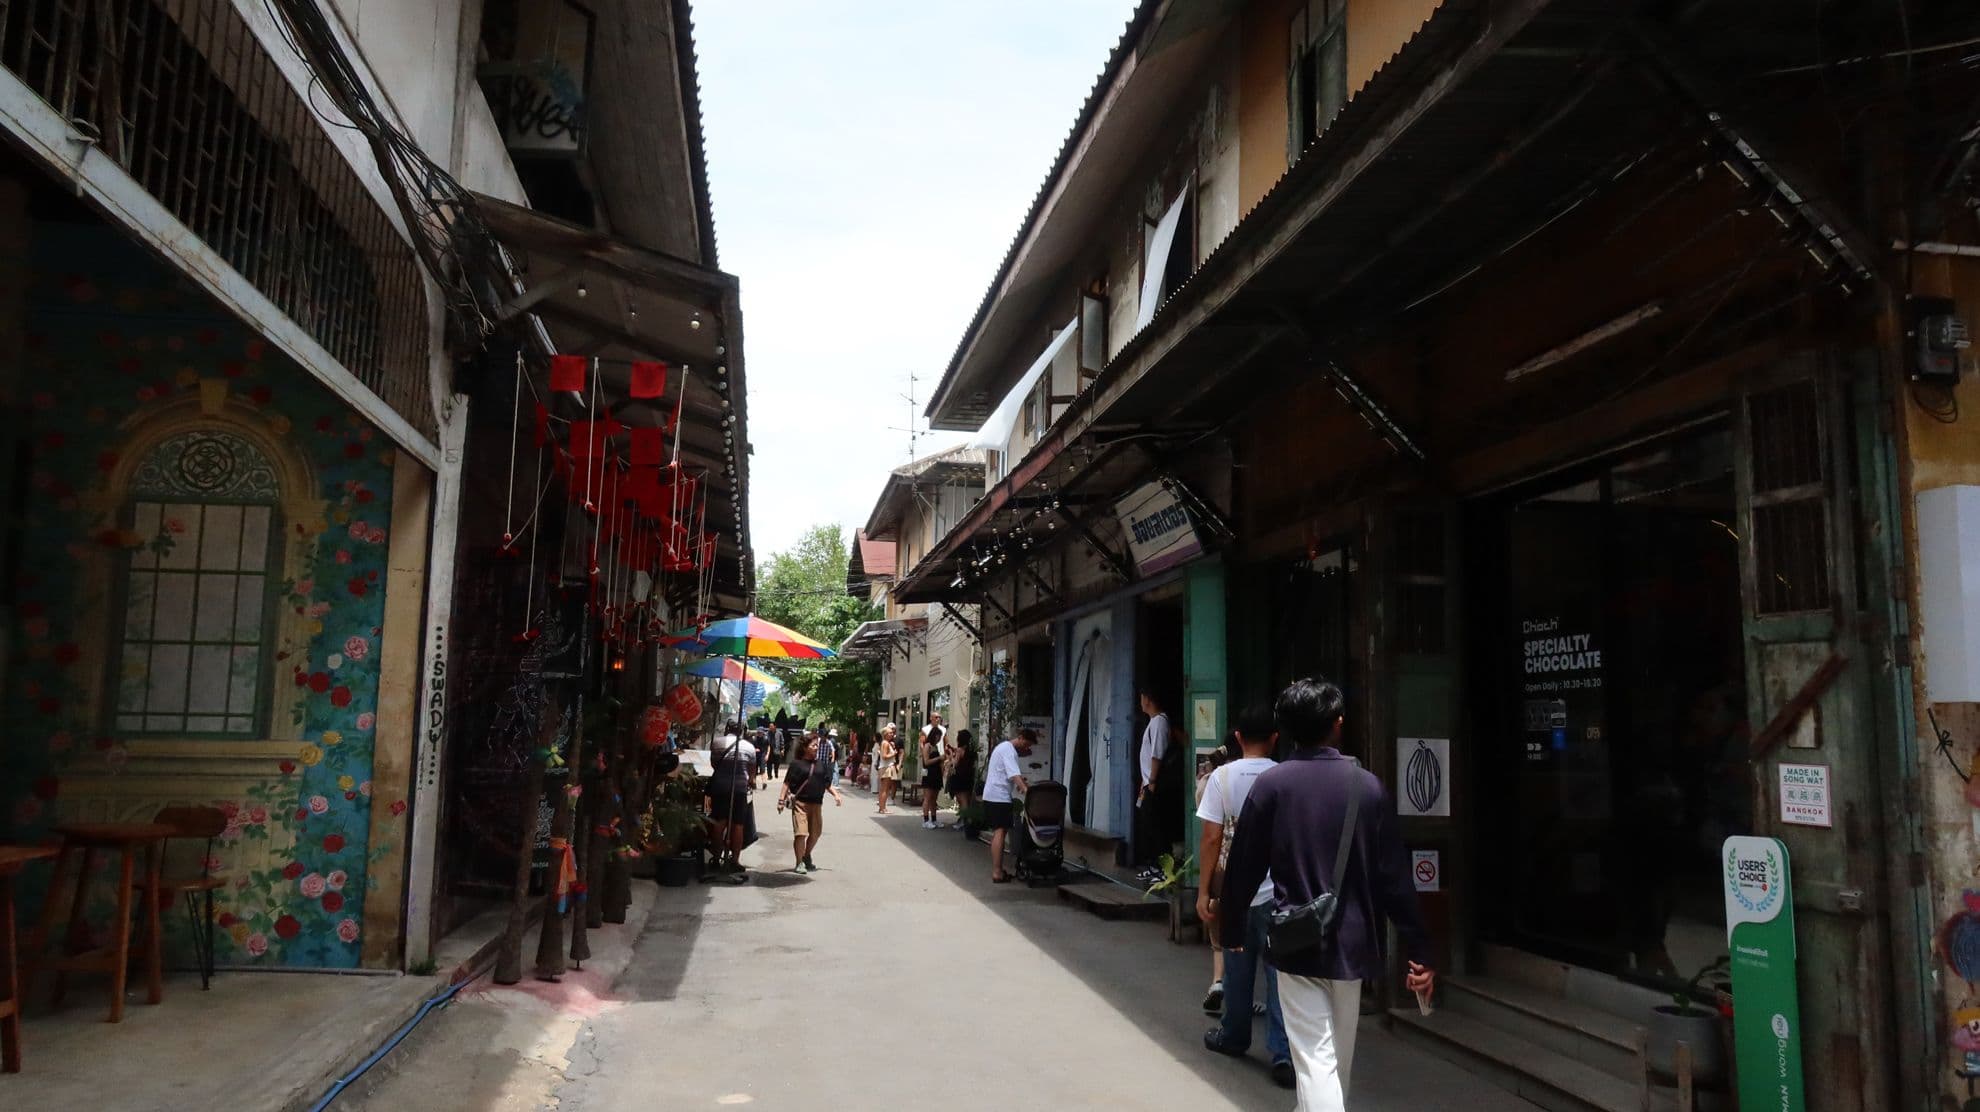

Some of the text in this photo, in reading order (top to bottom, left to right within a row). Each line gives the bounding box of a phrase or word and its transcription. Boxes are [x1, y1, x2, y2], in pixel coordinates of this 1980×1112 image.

[1523, 634, 1590, 657] SPECIALTY
[1524, 651, 1601, 673] CHOCOLATE
[1525, 683, 1541, 692] Open
[1542, 681, 1558, 692] Daily
[1786, 768, 1808, 776] MADE
[1783, 775, 1804, 783] SONG
[1786, 806, 1824, 815] BANGKOK
[1738, 872, 1767, 882] CHOICE
